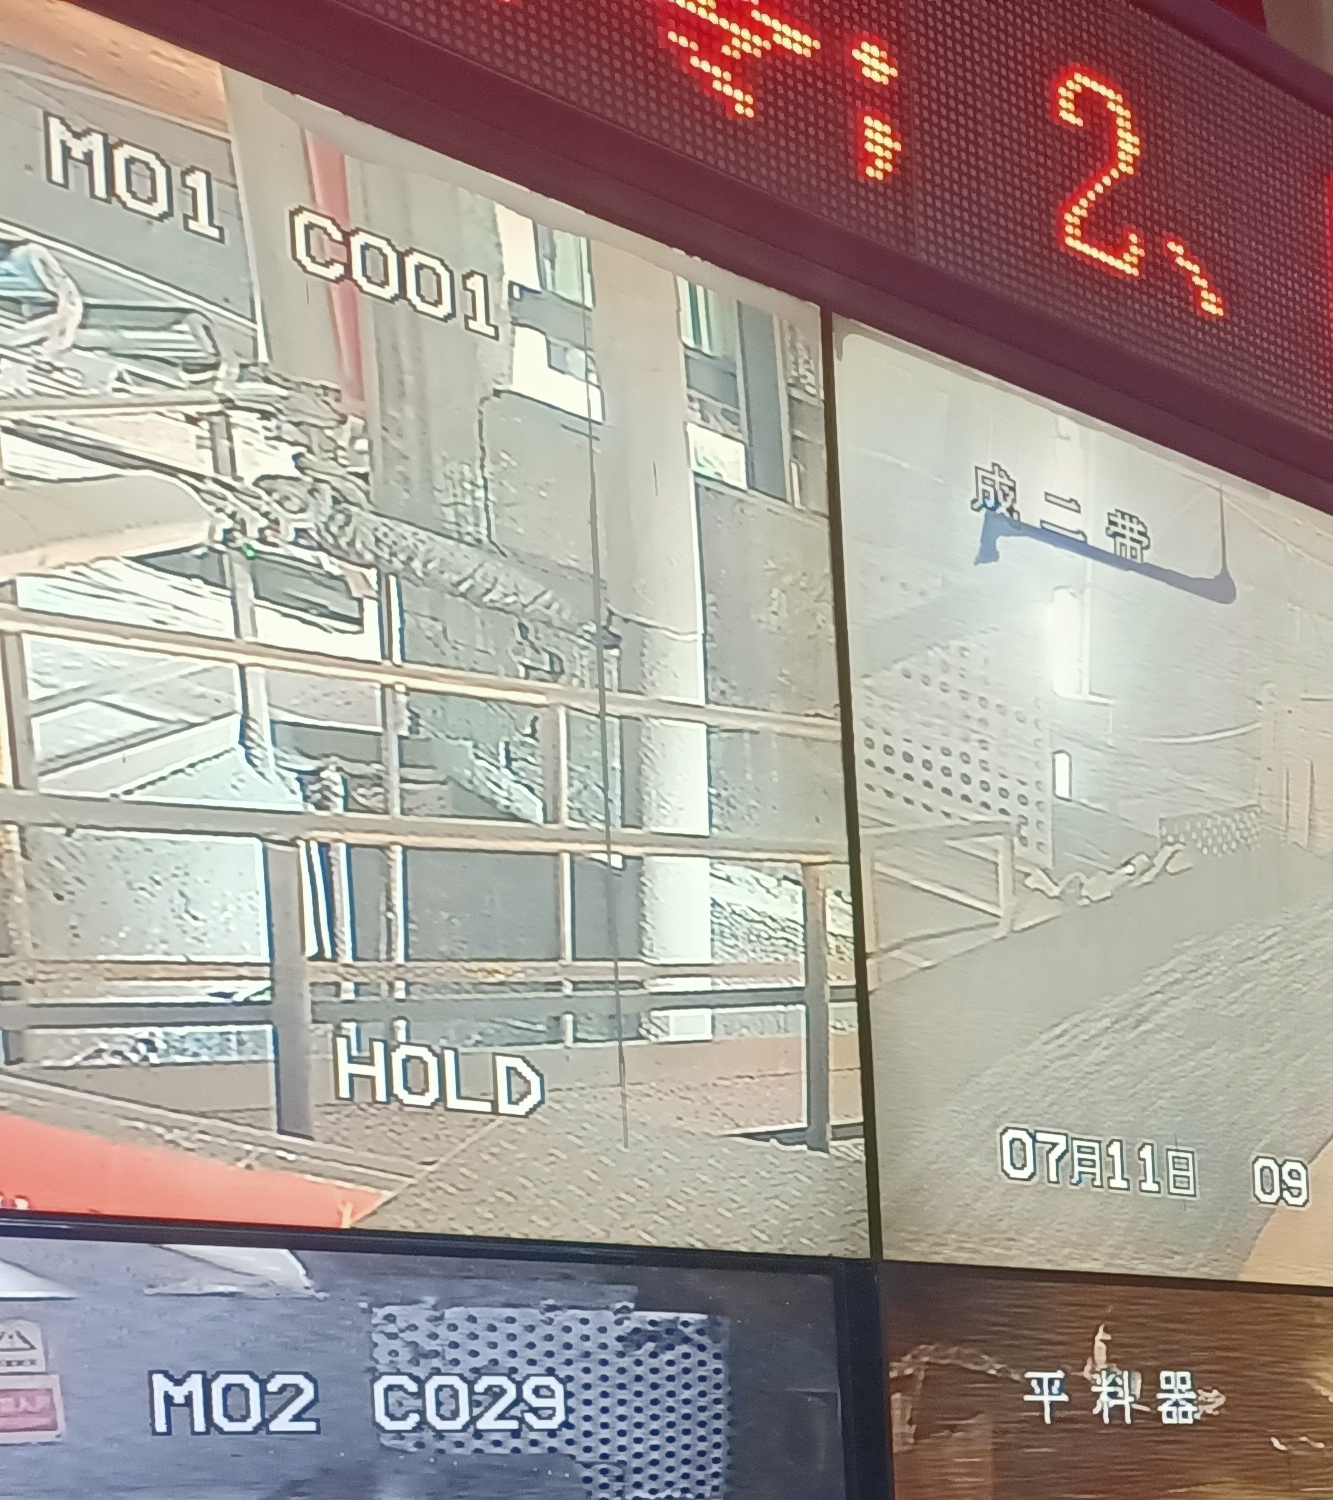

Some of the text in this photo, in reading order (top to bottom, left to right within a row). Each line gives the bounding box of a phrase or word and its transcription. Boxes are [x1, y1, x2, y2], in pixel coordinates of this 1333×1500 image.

[41, 109, 503, 342] M01 C001
[971, 461, 1150, 566] 成二带
[332, 1031, 546, 1119] HOLD
[998, 1126, 1198, 1198] 07月11日
[1252, 1156, 1310, 1207] 09
[148, 1369, 568, 1436] M02 C029
[1023, 1369, 1196, 1425] 平料器
